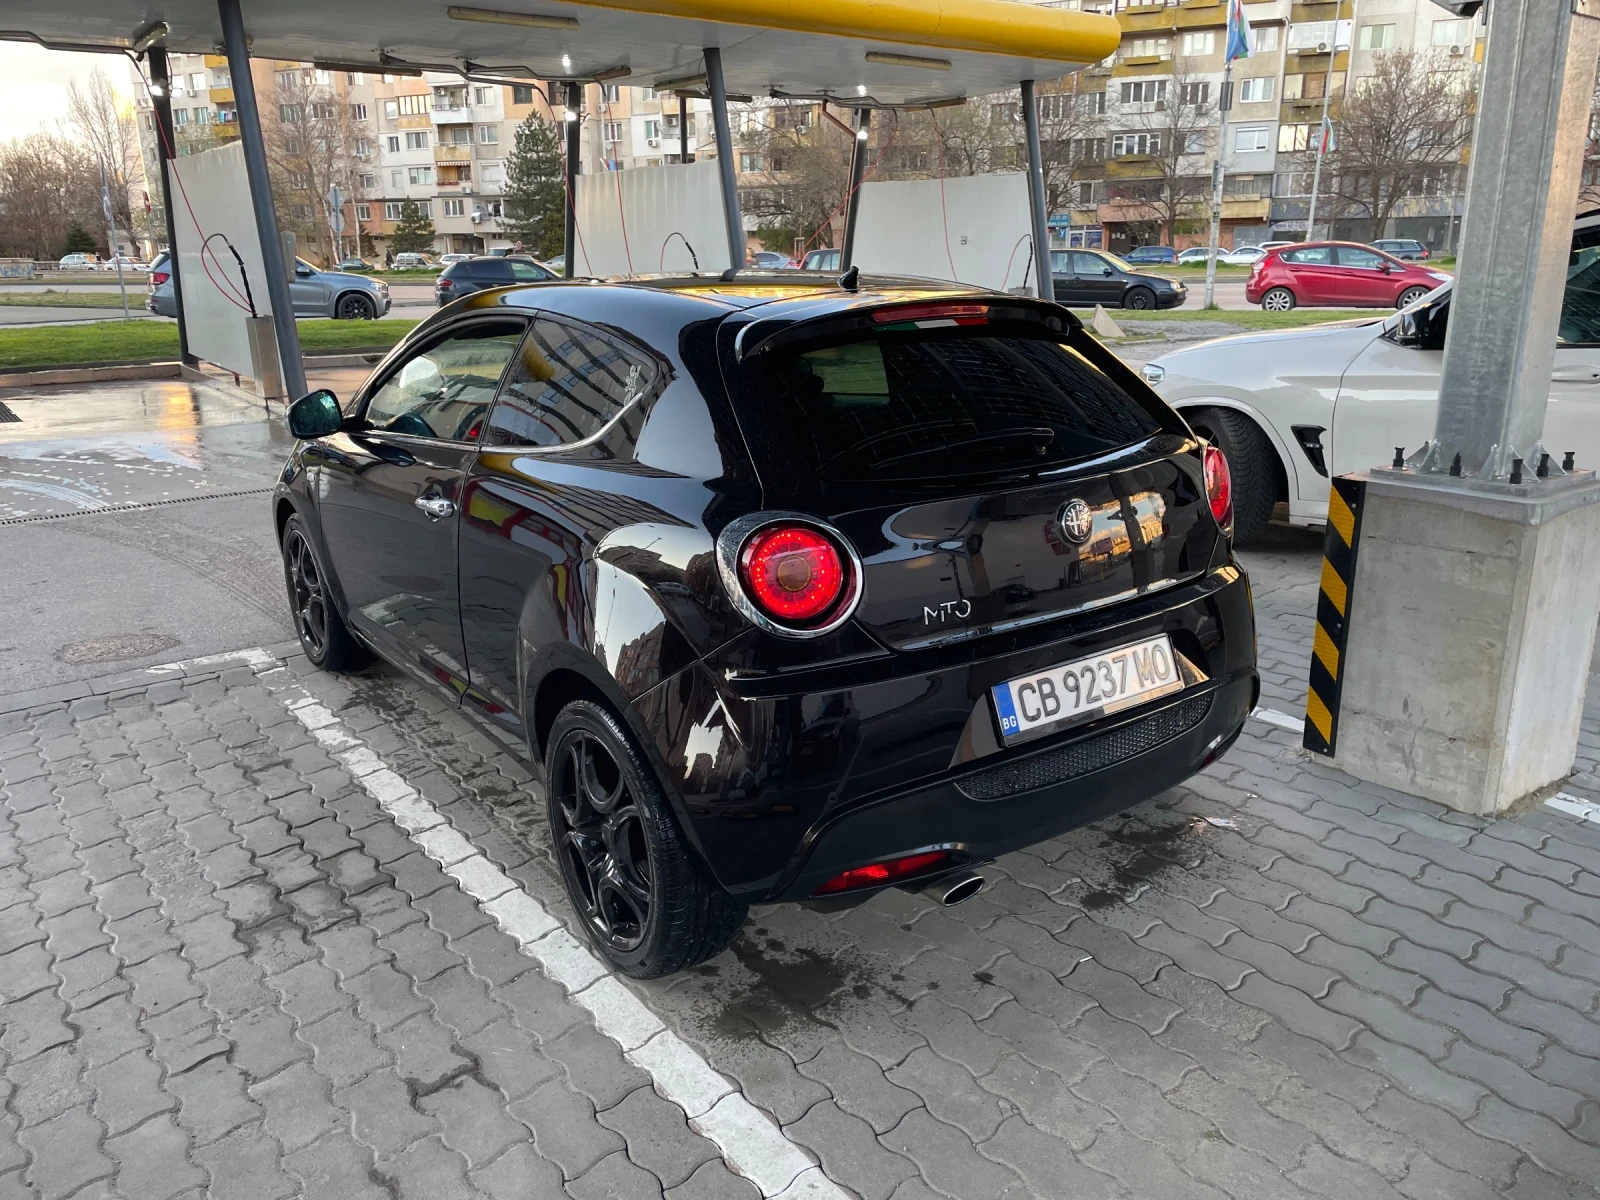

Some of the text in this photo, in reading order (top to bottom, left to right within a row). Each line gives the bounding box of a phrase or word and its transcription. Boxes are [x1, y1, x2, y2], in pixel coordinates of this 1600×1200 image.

[1017, 643, 1171, 723] CB 9237 MO
[1003, 715, 1017, 730] BG
